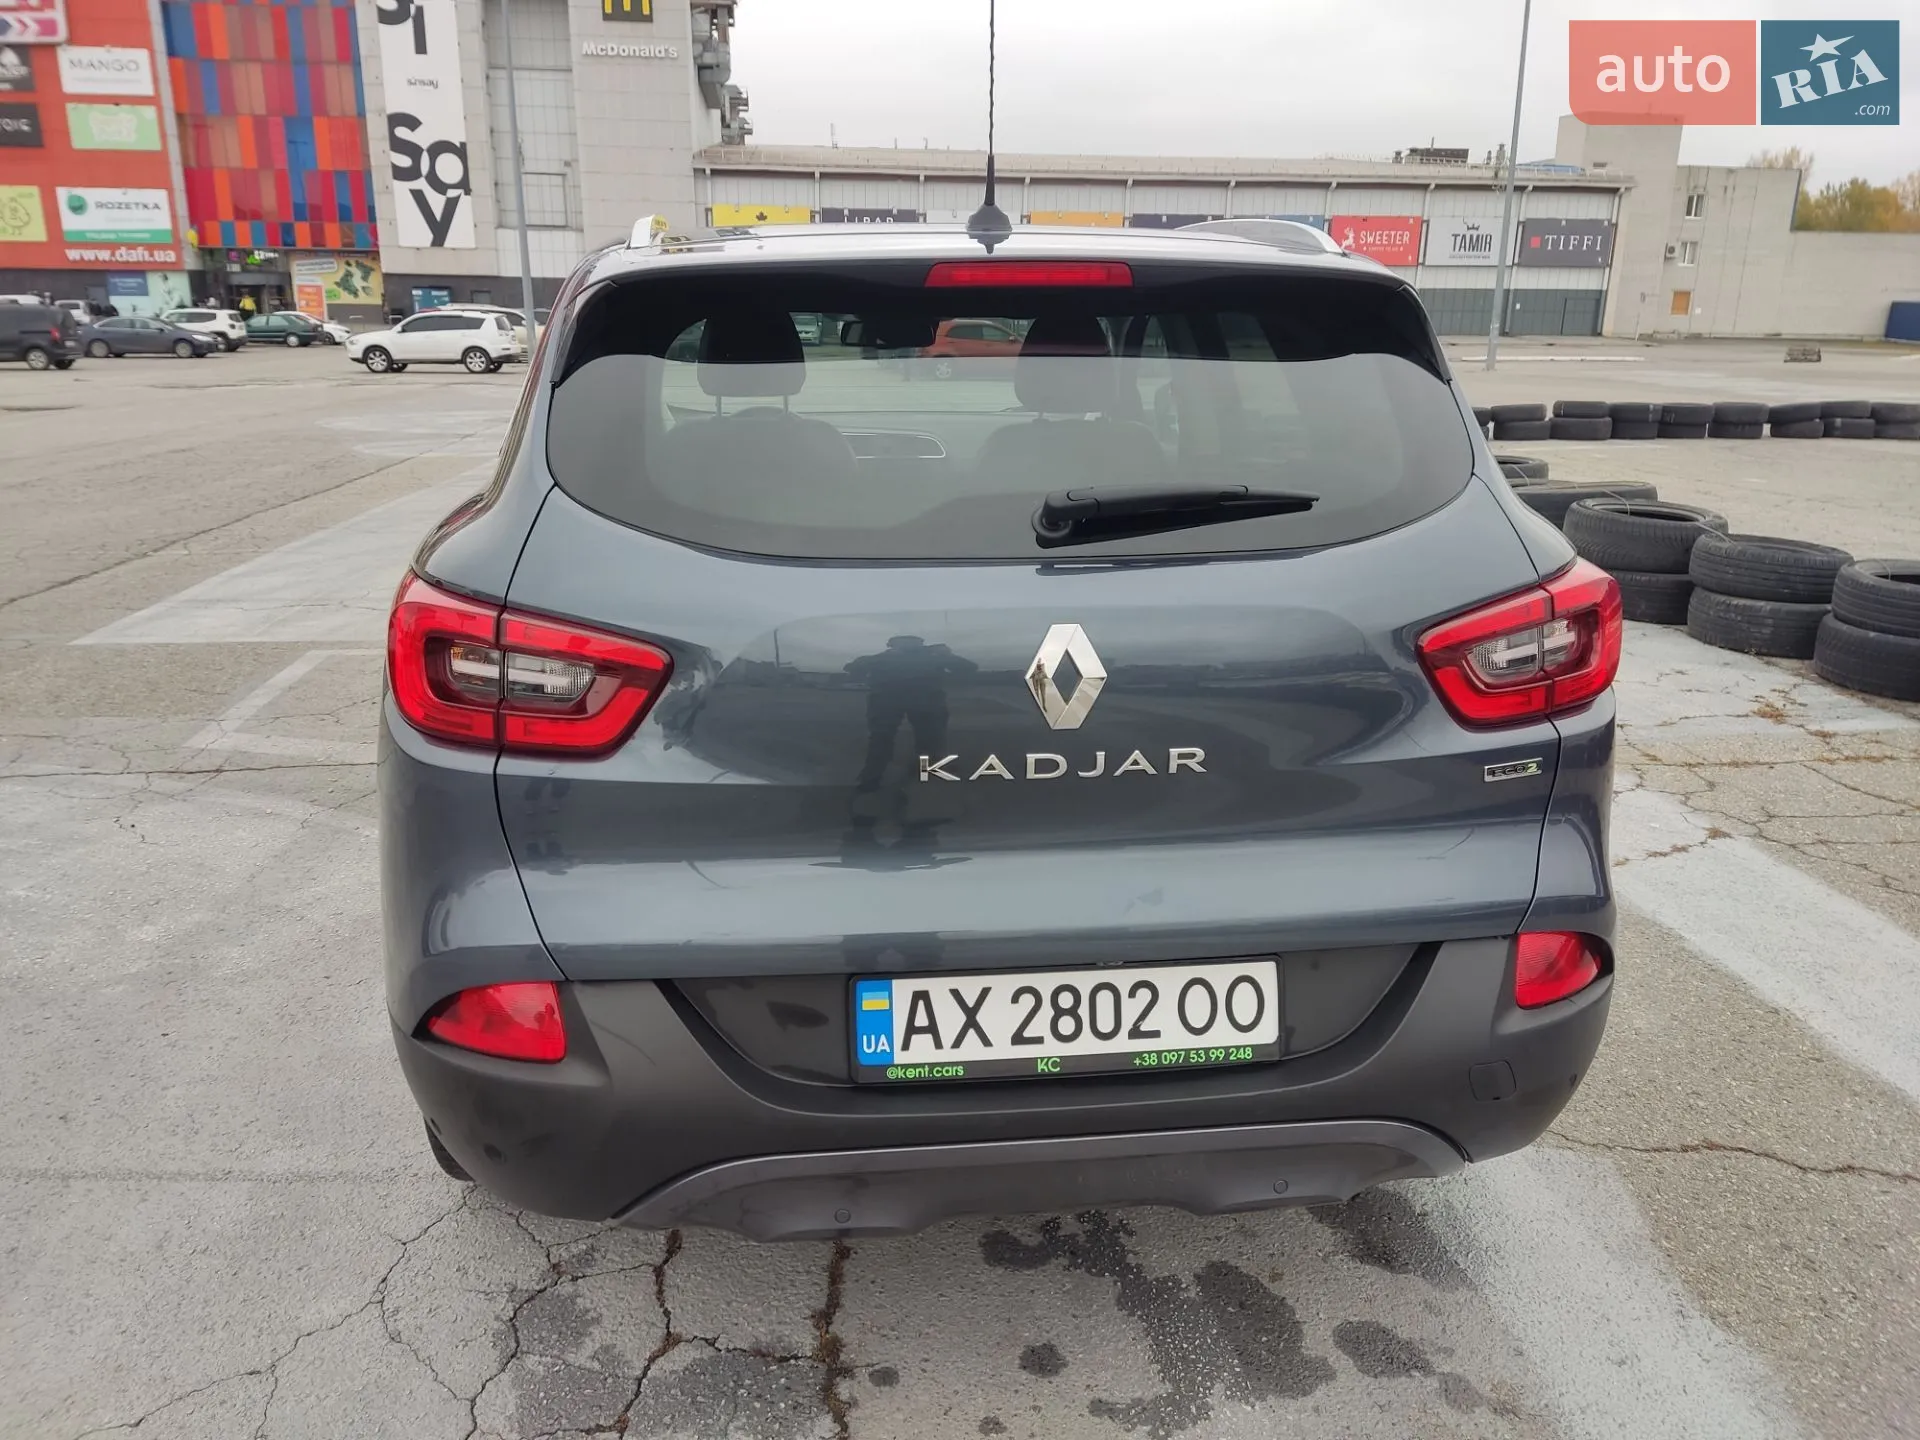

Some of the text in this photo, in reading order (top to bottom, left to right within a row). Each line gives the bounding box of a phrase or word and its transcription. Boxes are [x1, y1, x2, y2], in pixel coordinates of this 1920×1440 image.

[582, 41, 678, 59] McDonald's
[69, 58, 140, 73] MANGO
[94, 201, 162, 211] ROZETKA
[1359, 230, 1410, 245] SWEETER
[1451, 233, 1493, 253] TAMIR
[1544, 234, 1603, 251] TIFFI
[64, 246, 176, 263] www.dafi.ua
[919, 747, 1208, 782] KADJAR
[900, 986, 994, 1052] AX
[1010, 979, 1161, 1046] 2802
[862, 1034, 891, 1054] UA
[1037, 1057, 1061, 1073] KC
[1133, 1046, 1253, 1067] +38 097 53 99 248
[886, 1065, 965, 1080] @kent.cars
